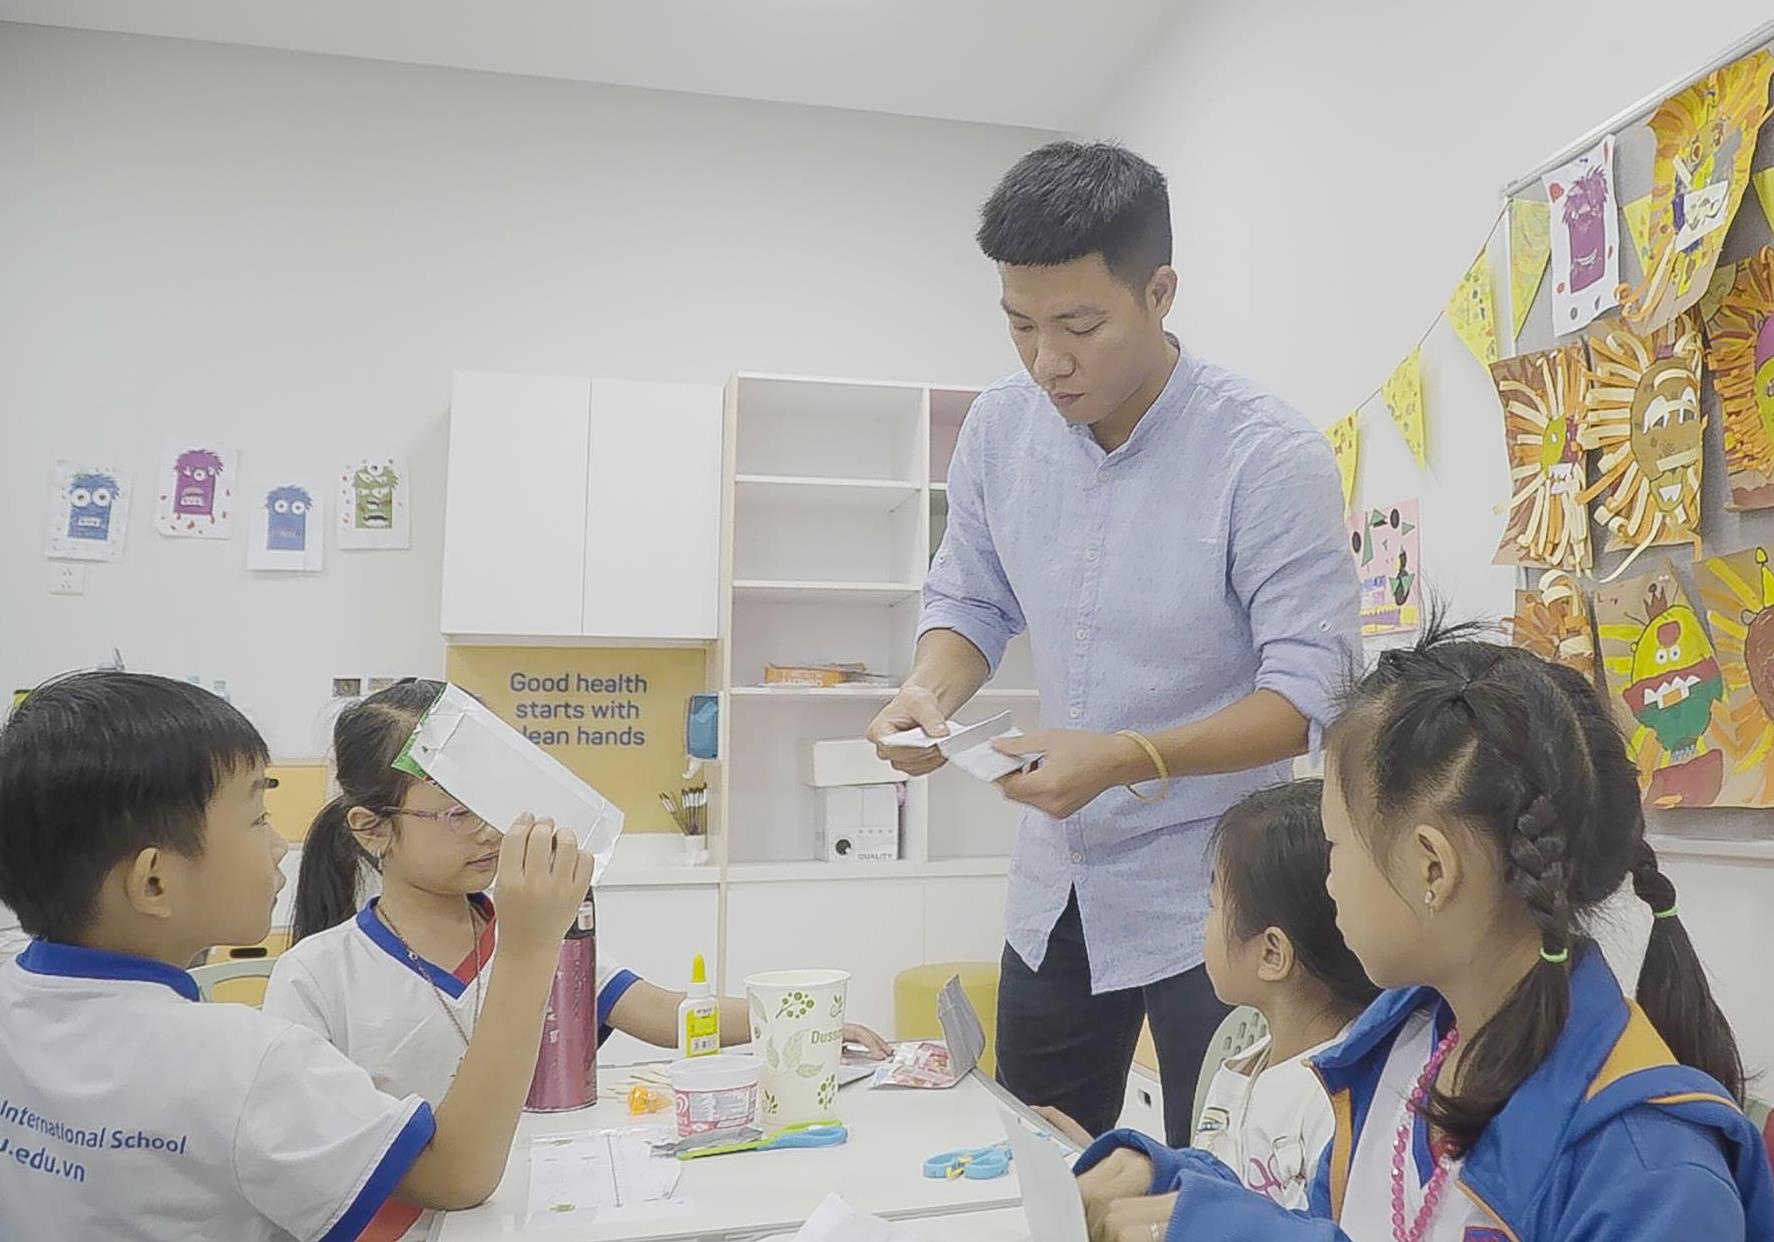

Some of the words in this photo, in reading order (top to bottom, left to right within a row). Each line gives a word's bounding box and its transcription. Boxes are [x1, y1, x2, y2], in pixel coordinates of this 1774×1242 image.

[510, 672, 569, 693] Good
[576, 672, 647, 694] health
[515, 701, 585, 719] starts
[591, 700, 640, 719] with
[519, 725, 570, 745] lean
[577, 725, 646, 745] hands
[856, 852, 893, 861] QUALITY
[0, 1099, 107, 1149] International
[110, 1129, 188, 1154] School
